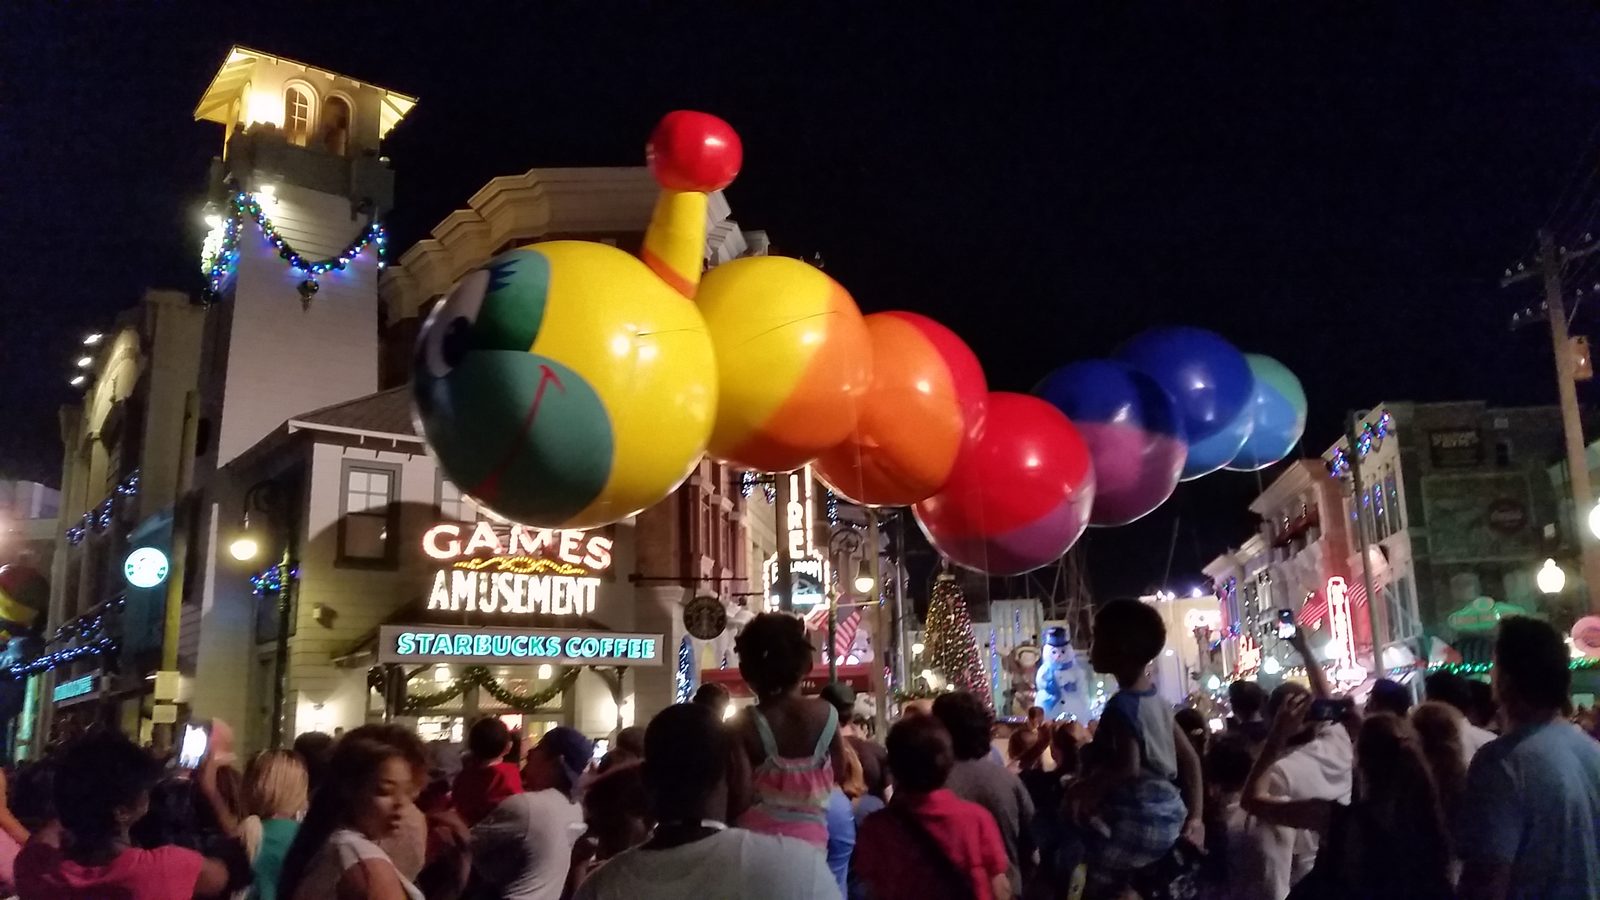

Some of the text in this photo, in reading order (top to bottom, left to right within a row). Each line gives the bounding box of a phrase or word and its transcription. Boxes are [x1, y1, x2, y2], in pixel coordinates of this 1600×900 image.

[422, 521, 614, 570] GAMES
[427, 569, 601, 616] AMUSEMENT
[397, 633, 656, 659] STARBUCKS COFFEE
